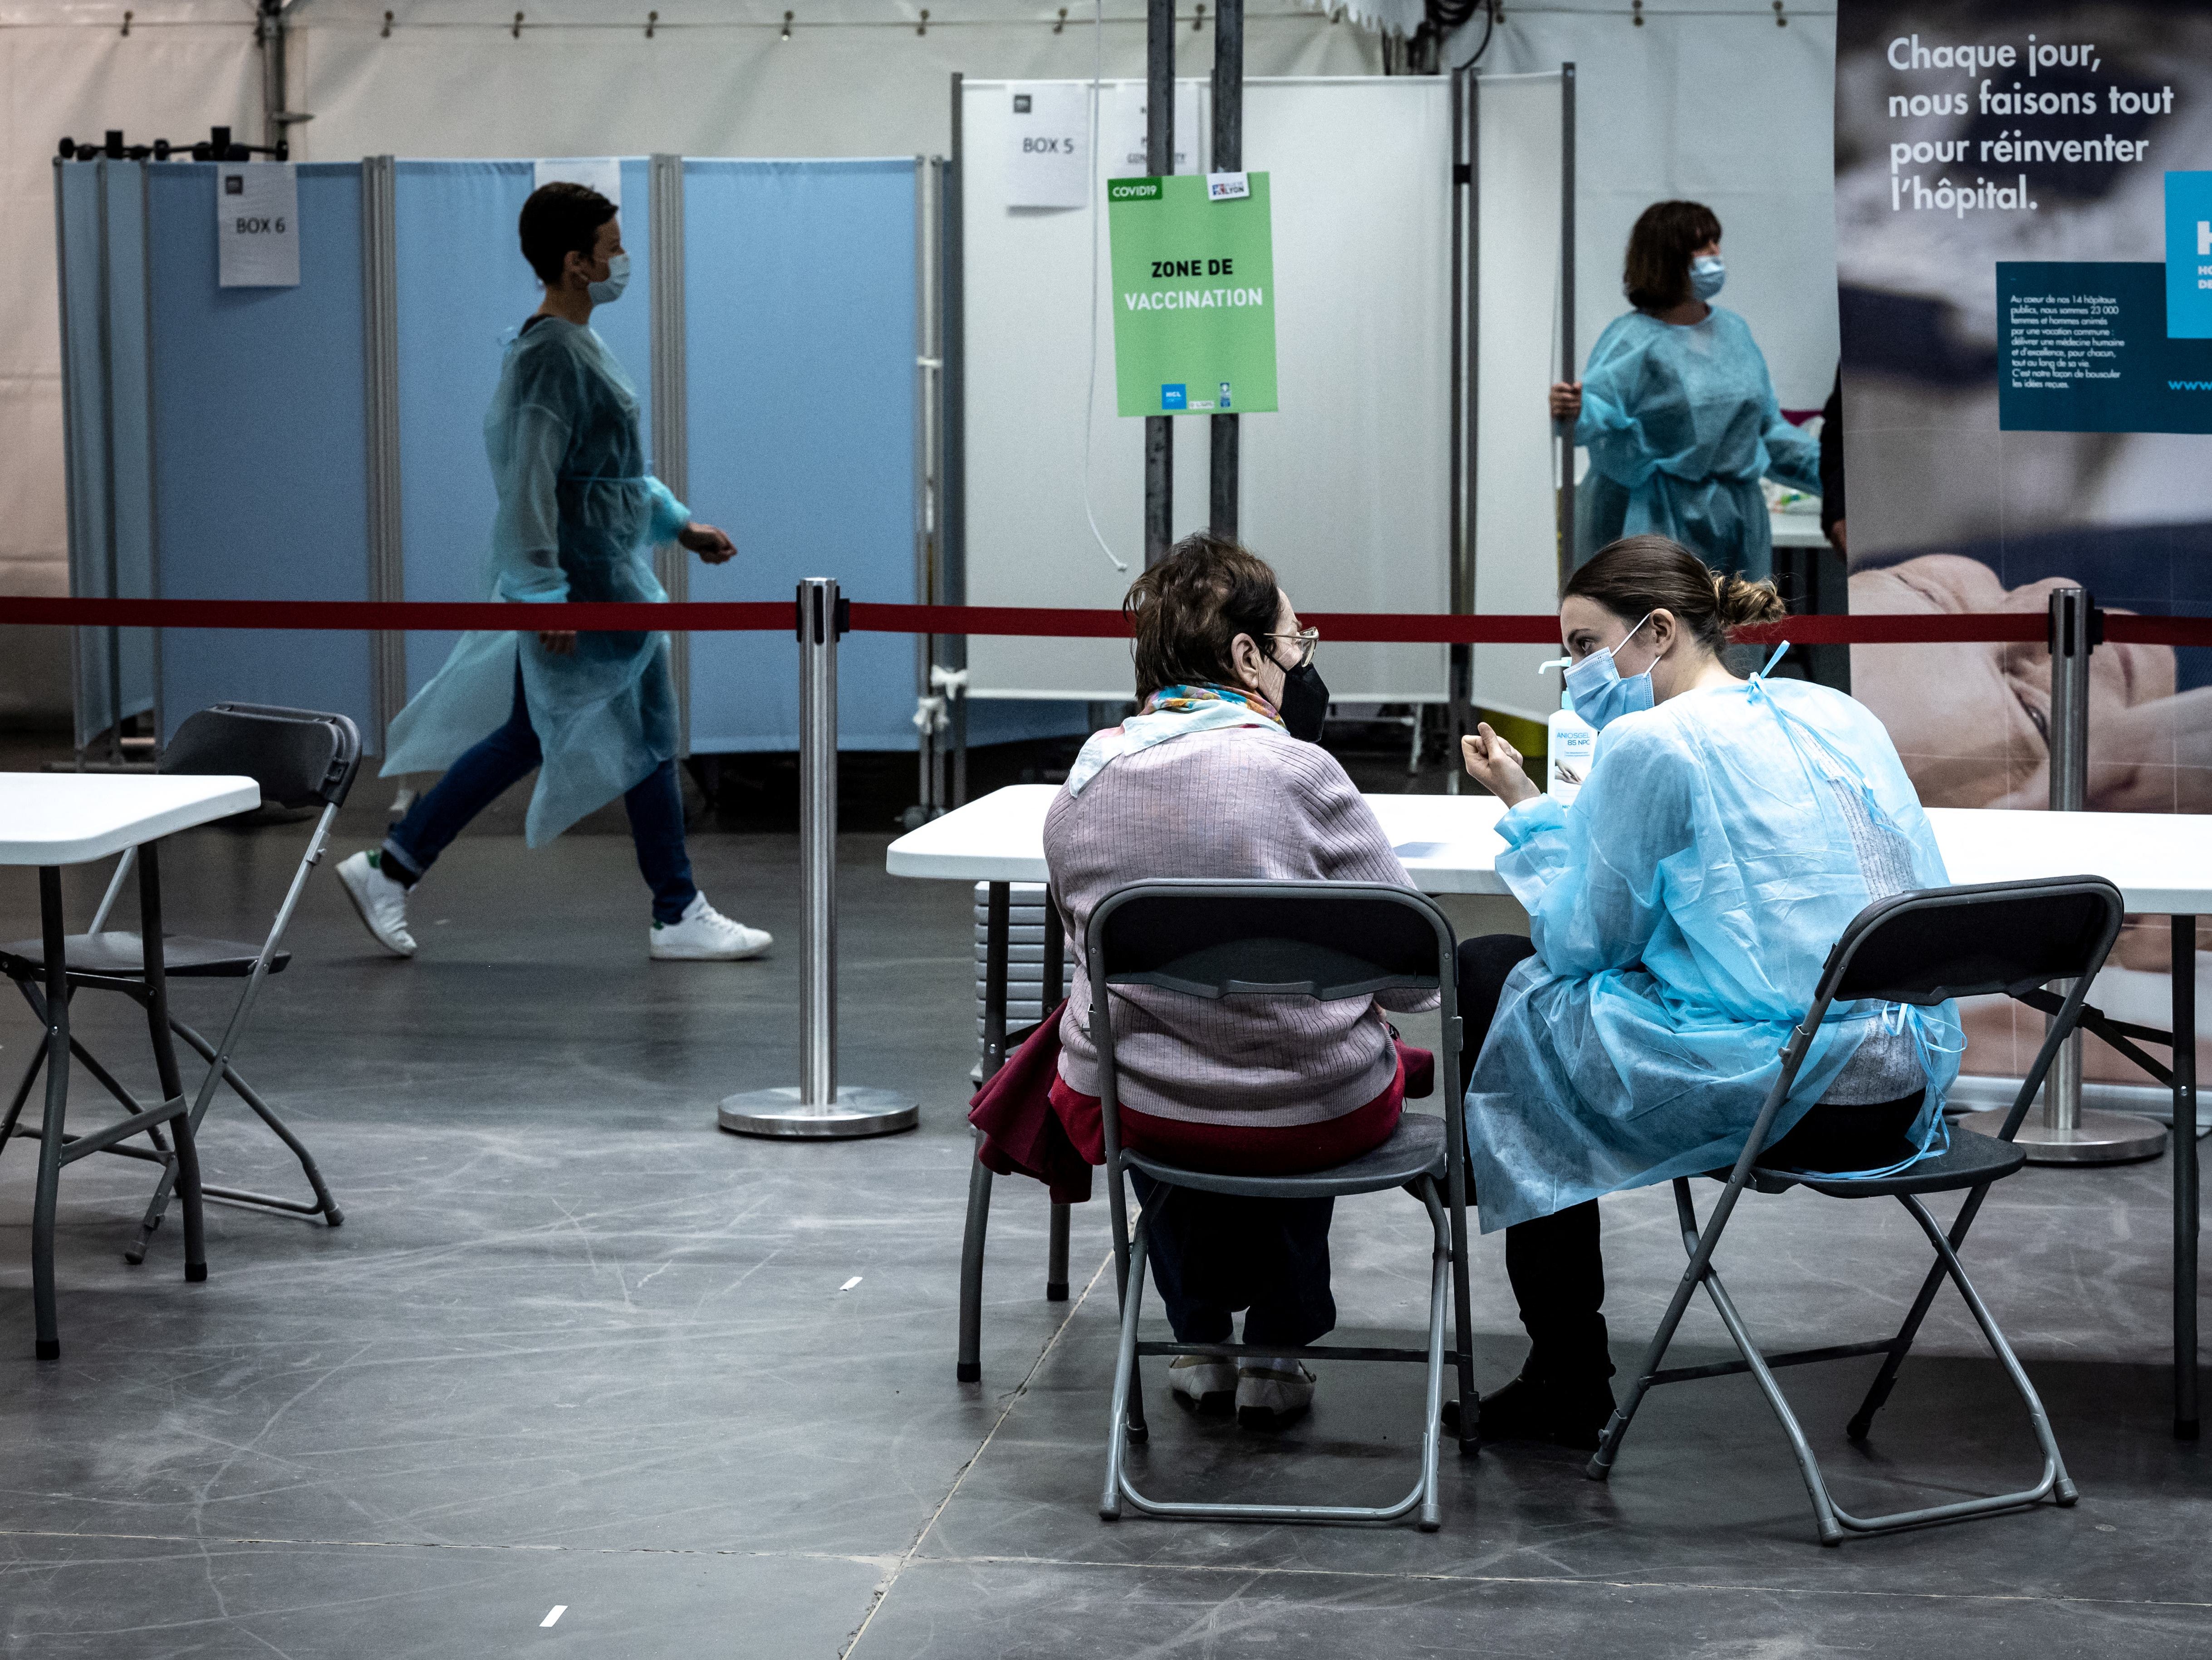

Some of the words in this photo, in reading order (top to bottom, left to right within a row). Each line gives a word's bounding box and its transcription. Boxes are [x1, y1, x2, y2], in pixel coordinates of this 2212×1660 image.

[1888, 34, 2016, 77] Chaque
[2028, 34, 2101, 77] jour,
[1889, 93, 1968, 117] nous
[1979, 79, 2097, 115] faisons
[2109, 86, 2174, 114] tout
[1023, 137, 1058, 153] BOX
[1064, 137, 1074, 154] 5
[1891, 140, 1970, 174] pour
[1981, 129, 2149, 162] réinventer
[1112, 185, 1157, 197] COVID19
[1892, 174, 2038, 219] l'hôpital.
[236, 217, 271, 234] BOX
[275, 217, 285, 234] 6
[1152, 260, 1202, 278] ZONE
[1208, 259, 1233, 275] DE
[1124, 287, 1263, 310] VACCINATION
[2045, 294, 2055, 304] de
[2073, 295, 2082, 304] 14
[2084, 294, 2116, 306] hôpitaux
[2090, 306, 2101, 314] 23
[2102, 306, 2119, 314] 000
[2049, 316, 2079, 324] hommes
[2042, 327, 2072, 335] vocation
[2055, 337, 2090, 346] médecine
[2092, 337, 2125, 347] humaine
[2068, 351, 2085, 359] pour
[2039, 357, 2055, 371] long
[2056, 358, 2066, 367] de
[2085, 369, 2121, 378] bousculer
